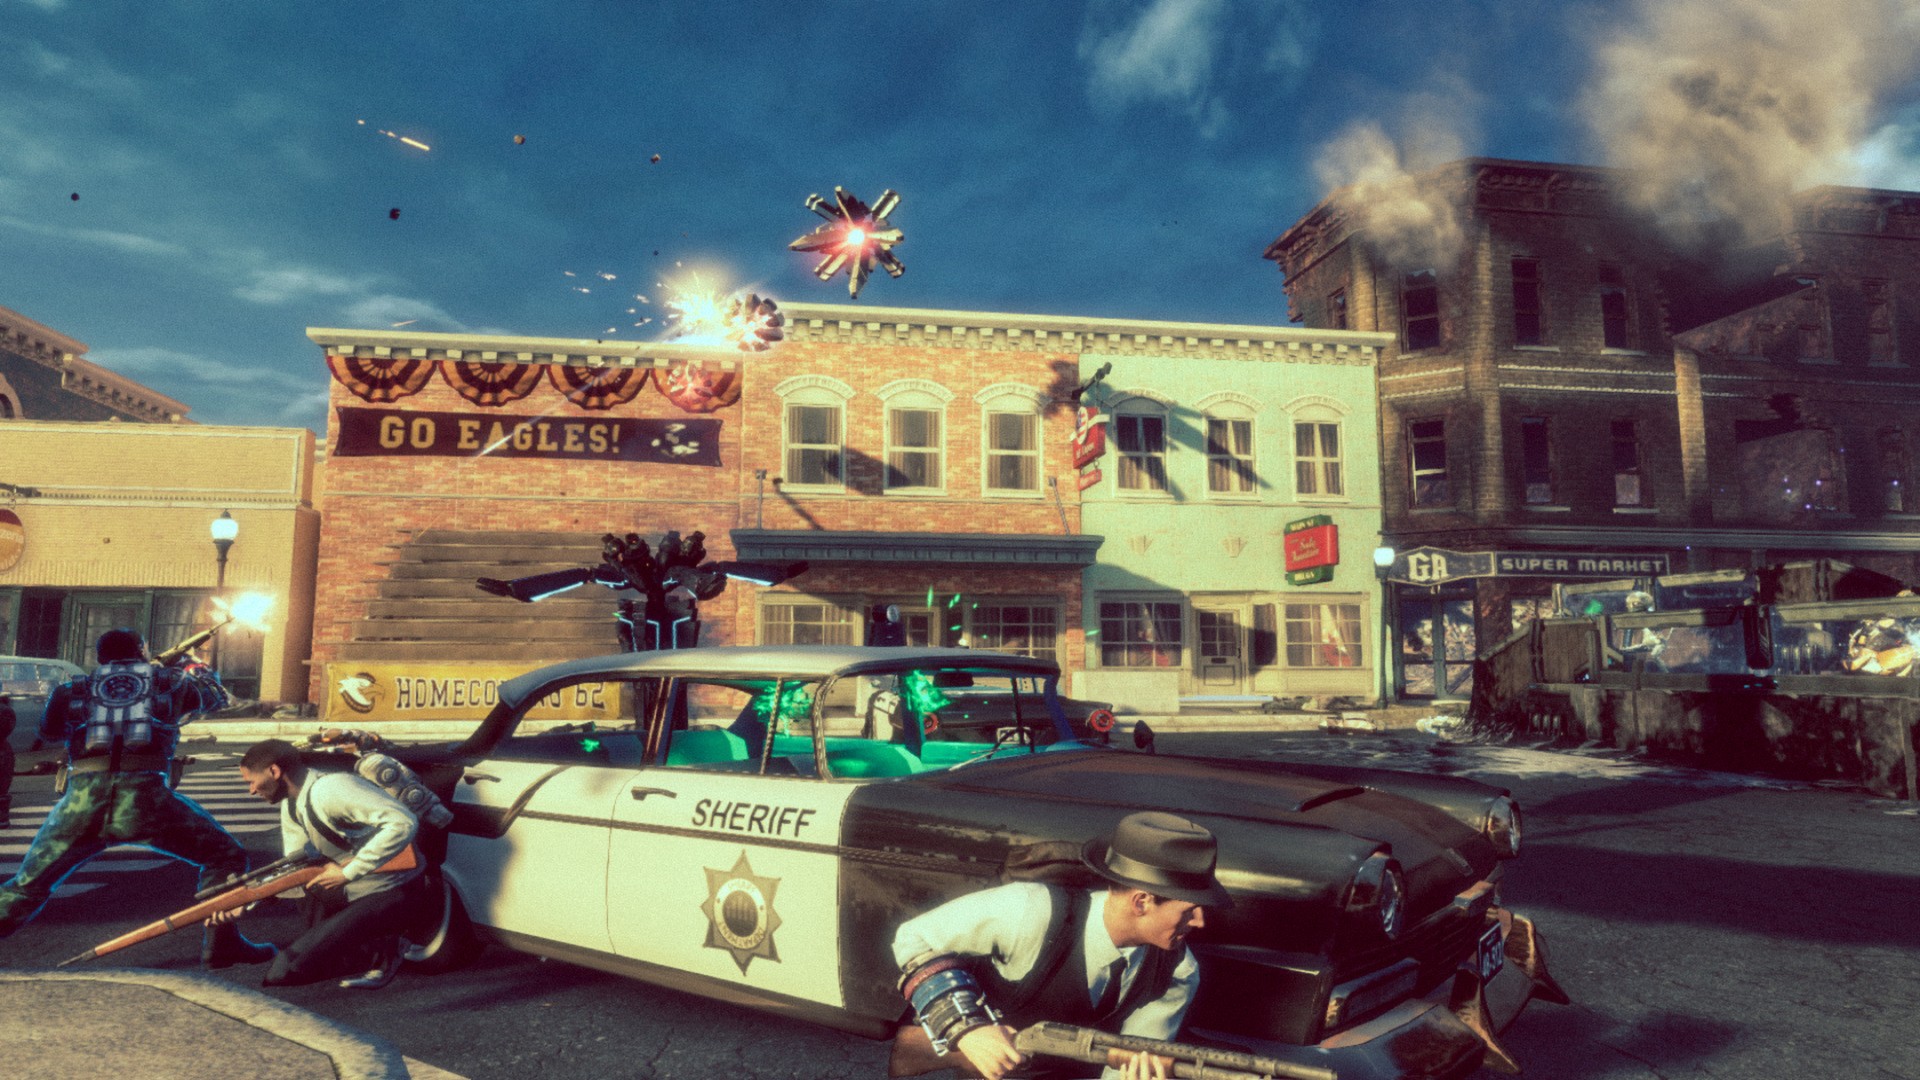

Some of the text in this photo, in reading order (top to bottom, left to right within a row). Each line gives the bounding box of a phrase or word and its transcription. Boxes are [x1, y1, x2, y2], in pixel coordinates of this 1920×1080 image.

[379, 415, 621, 454] GO EAGLES!
[1406, 552, 1450, 582] GA
[1501, 557, 1664, 573] SUPER MARKET
[691, 798, 817, 838] SHERIFF
